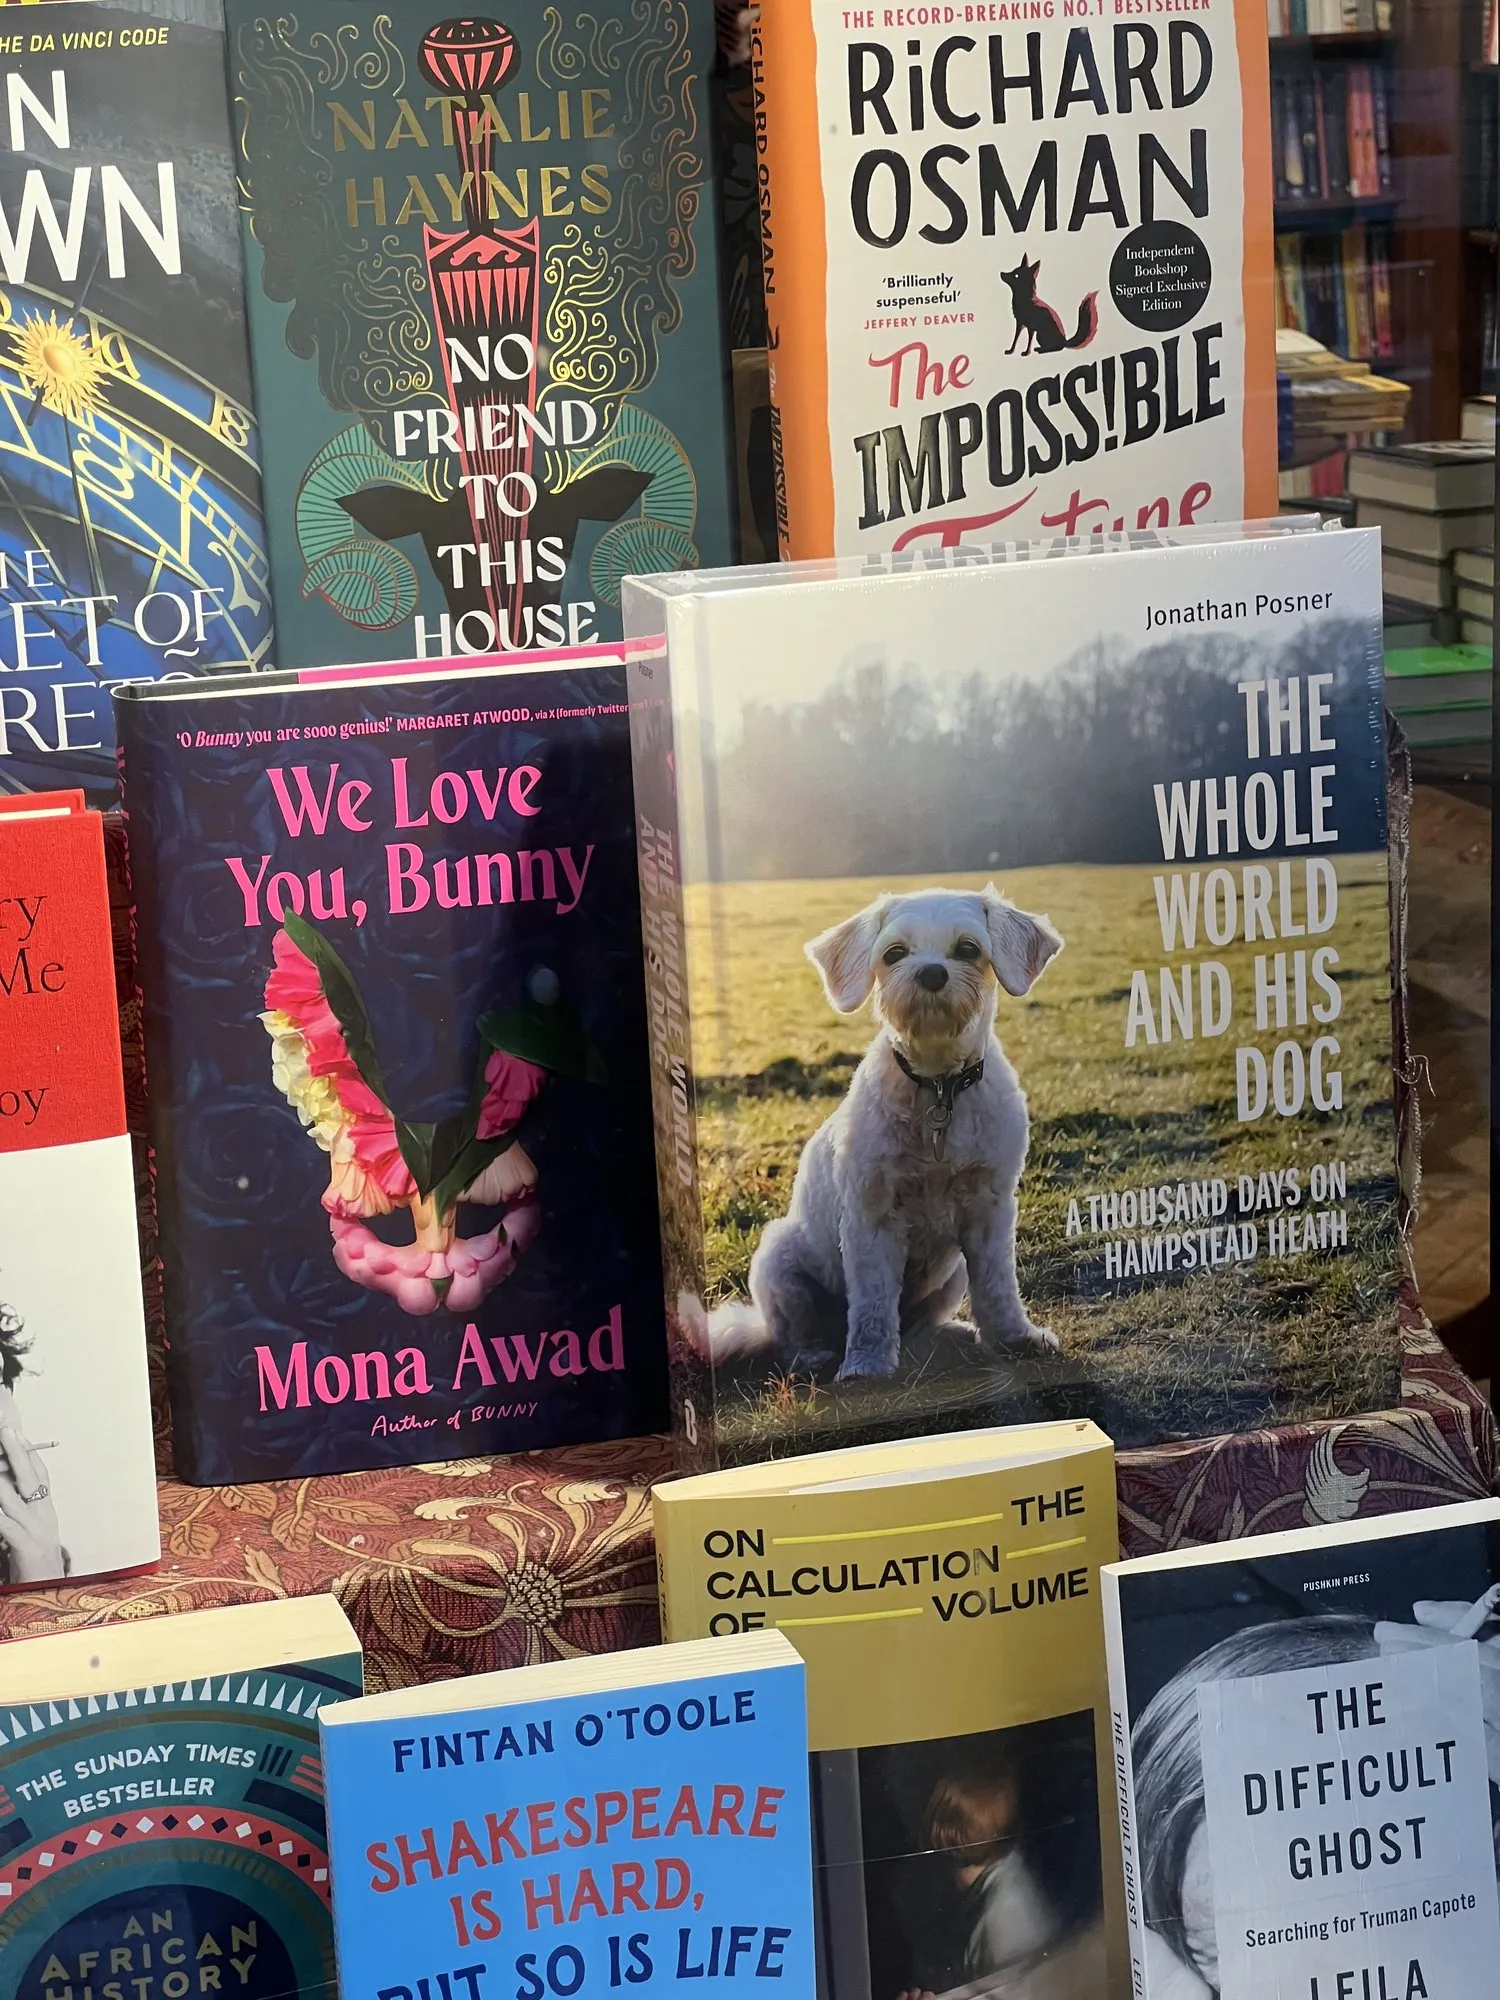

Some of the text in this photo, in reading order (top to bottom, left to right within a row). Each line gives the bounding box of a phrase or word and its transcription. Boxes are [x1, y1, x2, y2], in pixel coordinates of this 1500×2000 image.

[30, 34, 55, 52] DA
[62, 30, 114, 50] VINCI
[119, 27, 169, 47] CODE
[842, 11, 875, 29] THE
[884, 1, 1055, 27] RECORD-BREAKING
[6, 70, 71, 151] N
[326, 88, 615, 151] NATALIE
[345, 164, 613, 227] HAYNES
[851, 129, 1209, 249] OSMAN
[758, 163, 776, 294] OSMAN
[1125, 244, 1196, 261] Independent
[1115, 279, 1207, 298] Signed Exclusive
[1134, 263, 1189, 277] Bookshop
[864, 313, 975, 331] JEFFERY DEAVER
[1141, 299, 1183, 312] Edition
[445, 333, 535, 384] NO
[868, 341, 975, 409] The
[393, 400, 598, 457] FRIEND
[853, 322, 1226, 531] IMPOSS!BLE
[458, 471, 538, 520] TO
[437, 537, 567, 589] THIS
[0, 595, 119, 672] ET
[414, 601, 600, 659] HOUSE
[1146, 592, 1333, 630] Jonathan Posner
[195, 730, 244, 749] Bunny
[246, 730, 272, 747] you
[276, 727, 301, 742] are
[303, 724, 337, 740] sooo
[396, 713, 469, 732] MARGARET
[473, 708, 534, 727] ATWOOD,
[534, 710, 548, 720] via
[549, 708, 556, 719] X
[556, 705, 597, 720] (formerly
[1237, 673, 1336, 759] THE
[266, 756, 544, 838] We Love
[1153, 764, 1339, 860] WHOLE
[224, 841, 596, 928] You, Bunny
[1153, 857, 1339, 952] WORLD
[640, 813, 669, 1072] AND HIS DOG
[656, 828, 692, 1187] THE WHOLE WORLD
[1124, 945, 1342, 1048] AND HIS
[1236, 1036, 1343, 1123] DOG
[1065, 1161, 1347, 1238] A THOUSAND DAYS ON
[1105, 1210, 1348, 1280] HAMPSTEAD HEATH
[253, 1303, 626, 1412] Mona Awad
[370, 1401, 538, 1437] Author of BUNNY
[704, 1485, 1086, 1558] ON THE
[707, 1544, 1000, 1601] CALCULATION
[932, 1566, 1090, 1622] VOLUME
[1303, 1573, 1370, 1592] PUSHKIN PRESS
[1113, 1711, 1124, 1746] THE
[1307, 1682, 1387, 1735] THE
[15, 1742, 257, 1802] THE SUNDAY TIMES
[393, 1718, 554, 1773] FINTAN
[63, 1777, 216, 1820] BESTSELLER
[1116, 1754, 1132, 1856] DIFFICULT
[1243, 1740, 1456, 1816] DIFFICULT
[366, 1784, 787, 1894] SHAKESPEARE
[1288, 1816, 1427, 1881] GHOST
[122, 1909, 173, 1939] AN
[449, 1857, 705, 1947] IS HARD,
[1124, 1864, 1138, 1930] GHOST
[1245, 1893, 1477, 1950] Searching for Truman Capote
[39, 1920, 258, 1985] AFRICAN
[515, 1944, 586, 2000] SO
[608, 1932, 654, 1988] IS
[675, 1925, 793, 1979] LIFE
